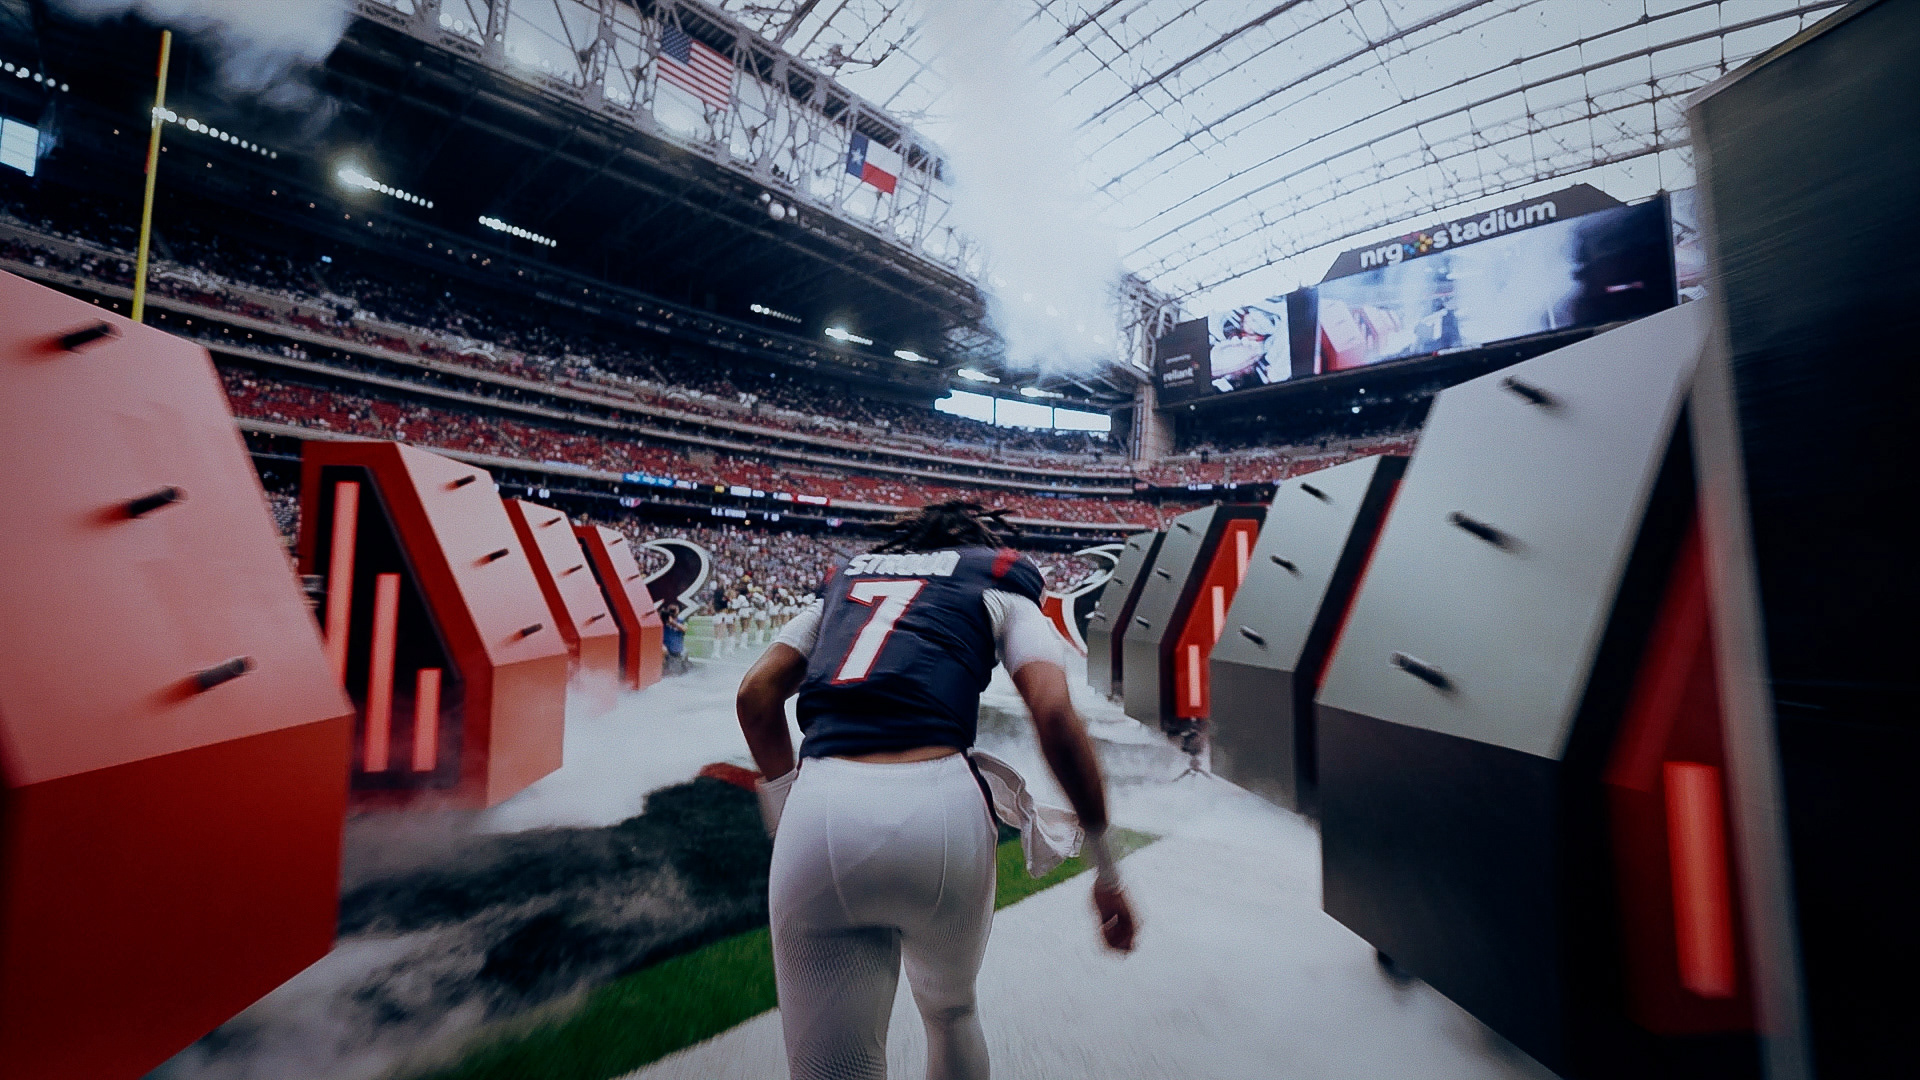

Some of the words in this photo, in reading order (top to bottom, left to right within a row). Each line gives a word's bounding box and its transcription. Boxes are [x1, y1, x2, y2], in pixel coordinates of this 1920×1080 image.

[1360, 243, 1404, 267] nrg
[1433, 201, 1557, 249] stadium
[1163, 367, 1194, 382] reliant
[844, 551, 960, 576] STROUD
[831, 578, 929, 685] 7
